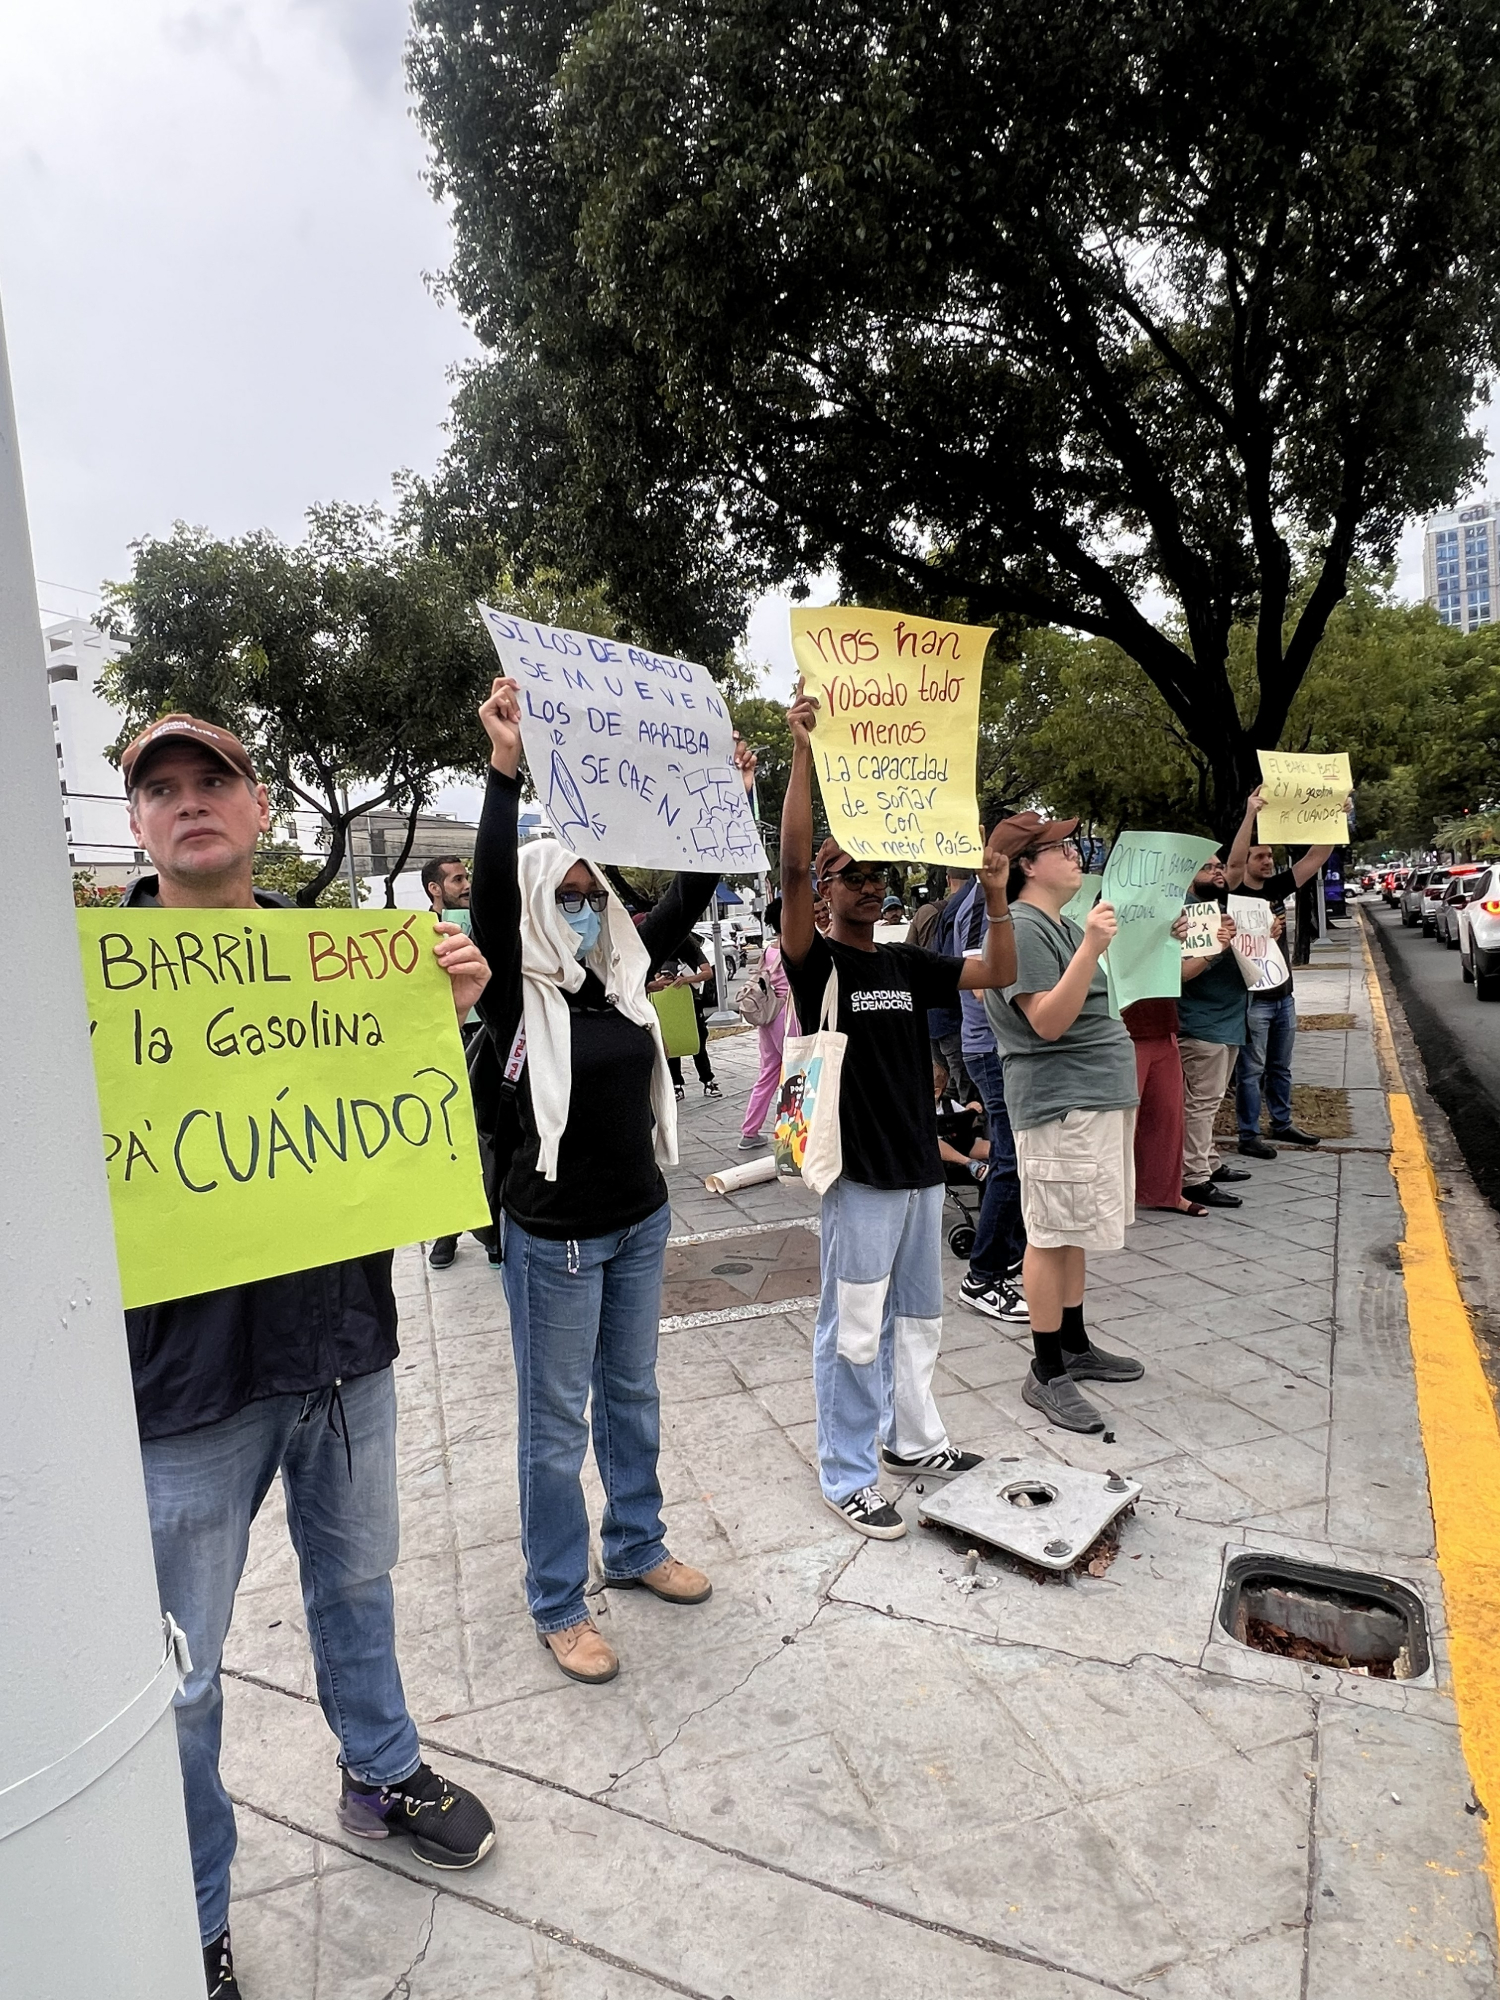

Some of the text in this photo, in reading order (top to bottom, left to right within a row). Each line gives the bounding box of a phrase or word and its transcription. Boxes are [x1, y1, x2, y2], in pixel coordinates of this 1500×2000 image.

[488, 613, 693, 683] SI LOS DE ABAJO
[893, 621, 961, 660] han
[519, 657, 724, 719] SE MUEVEN
[918, 664, 965, 703] todo
[525, 690, 710, 757] LOS DE ARRIBA
[850, 720, 927, 746] menos
[581, 754, 611, 785] SE
[841, 786, 869, 818] de
[881, 836, 925, 859] mejor
[309, 915, 420, 983] BAJÓ
[134, 1008, 174, 1066] la
[508, 1062, 519, 1081] FILA
[174, 1066, 459, 1193] CUÁNDO?
